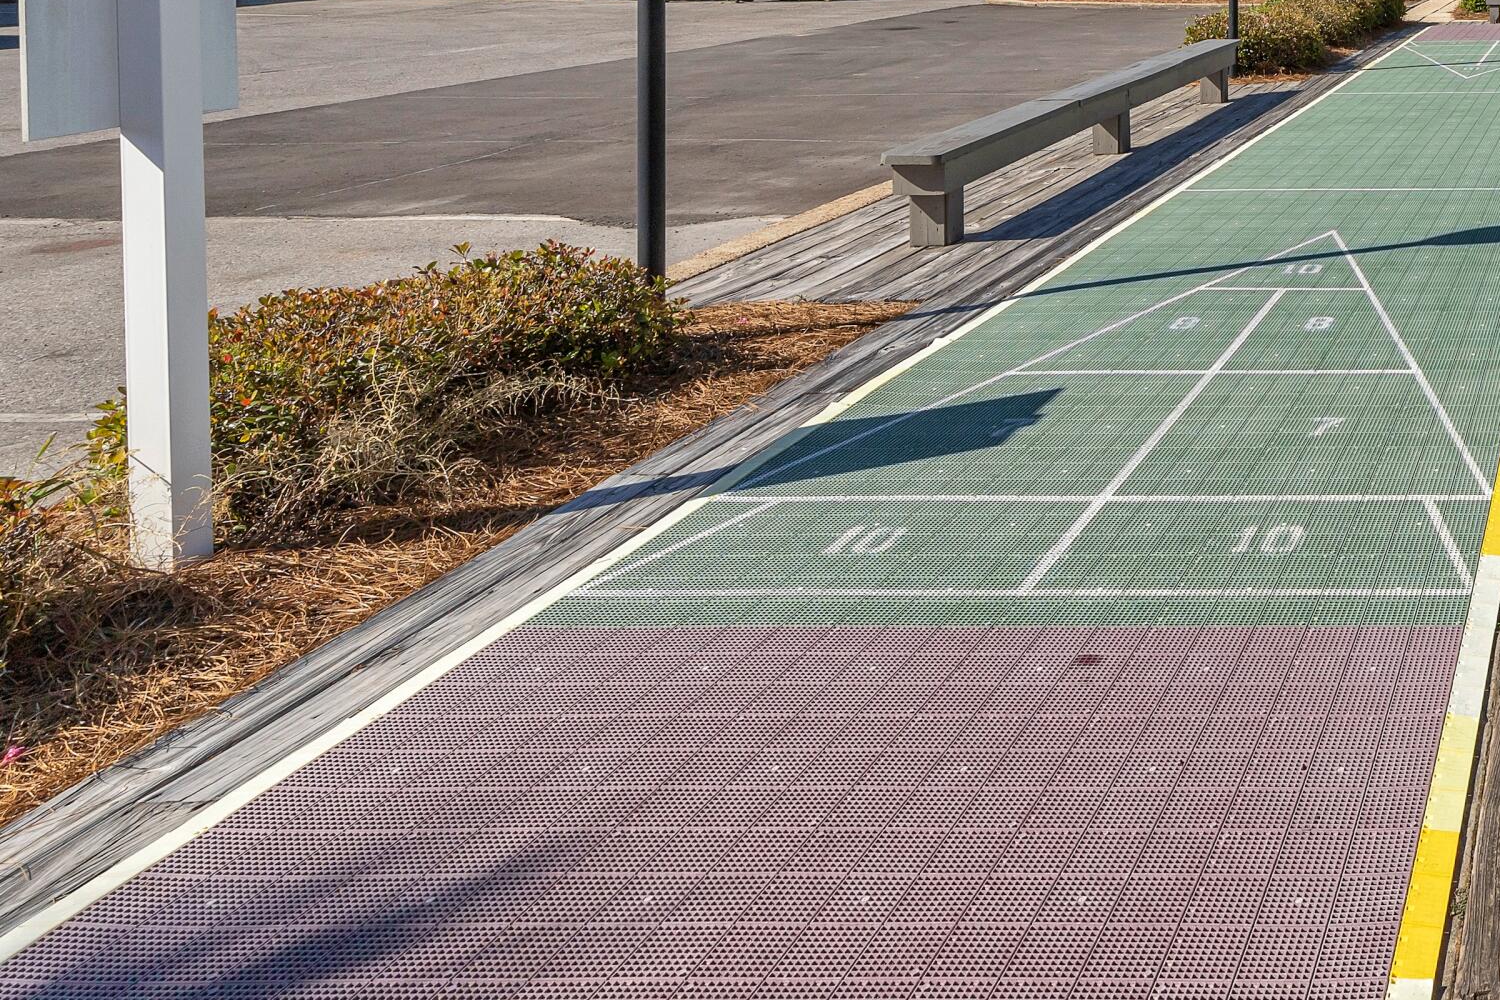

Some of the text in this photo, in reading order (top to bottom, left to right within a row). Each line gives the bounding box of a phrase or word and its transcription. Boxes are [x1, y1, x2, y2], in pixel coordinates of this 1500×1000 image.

[1282, 264, 1323, 275] 10
[1304, 316, 1335, 331] 8
[1308, 417, 1345, 437] 7
[822, 524, 907, 555] 10
[1231, 525, 1304, 554] 10
